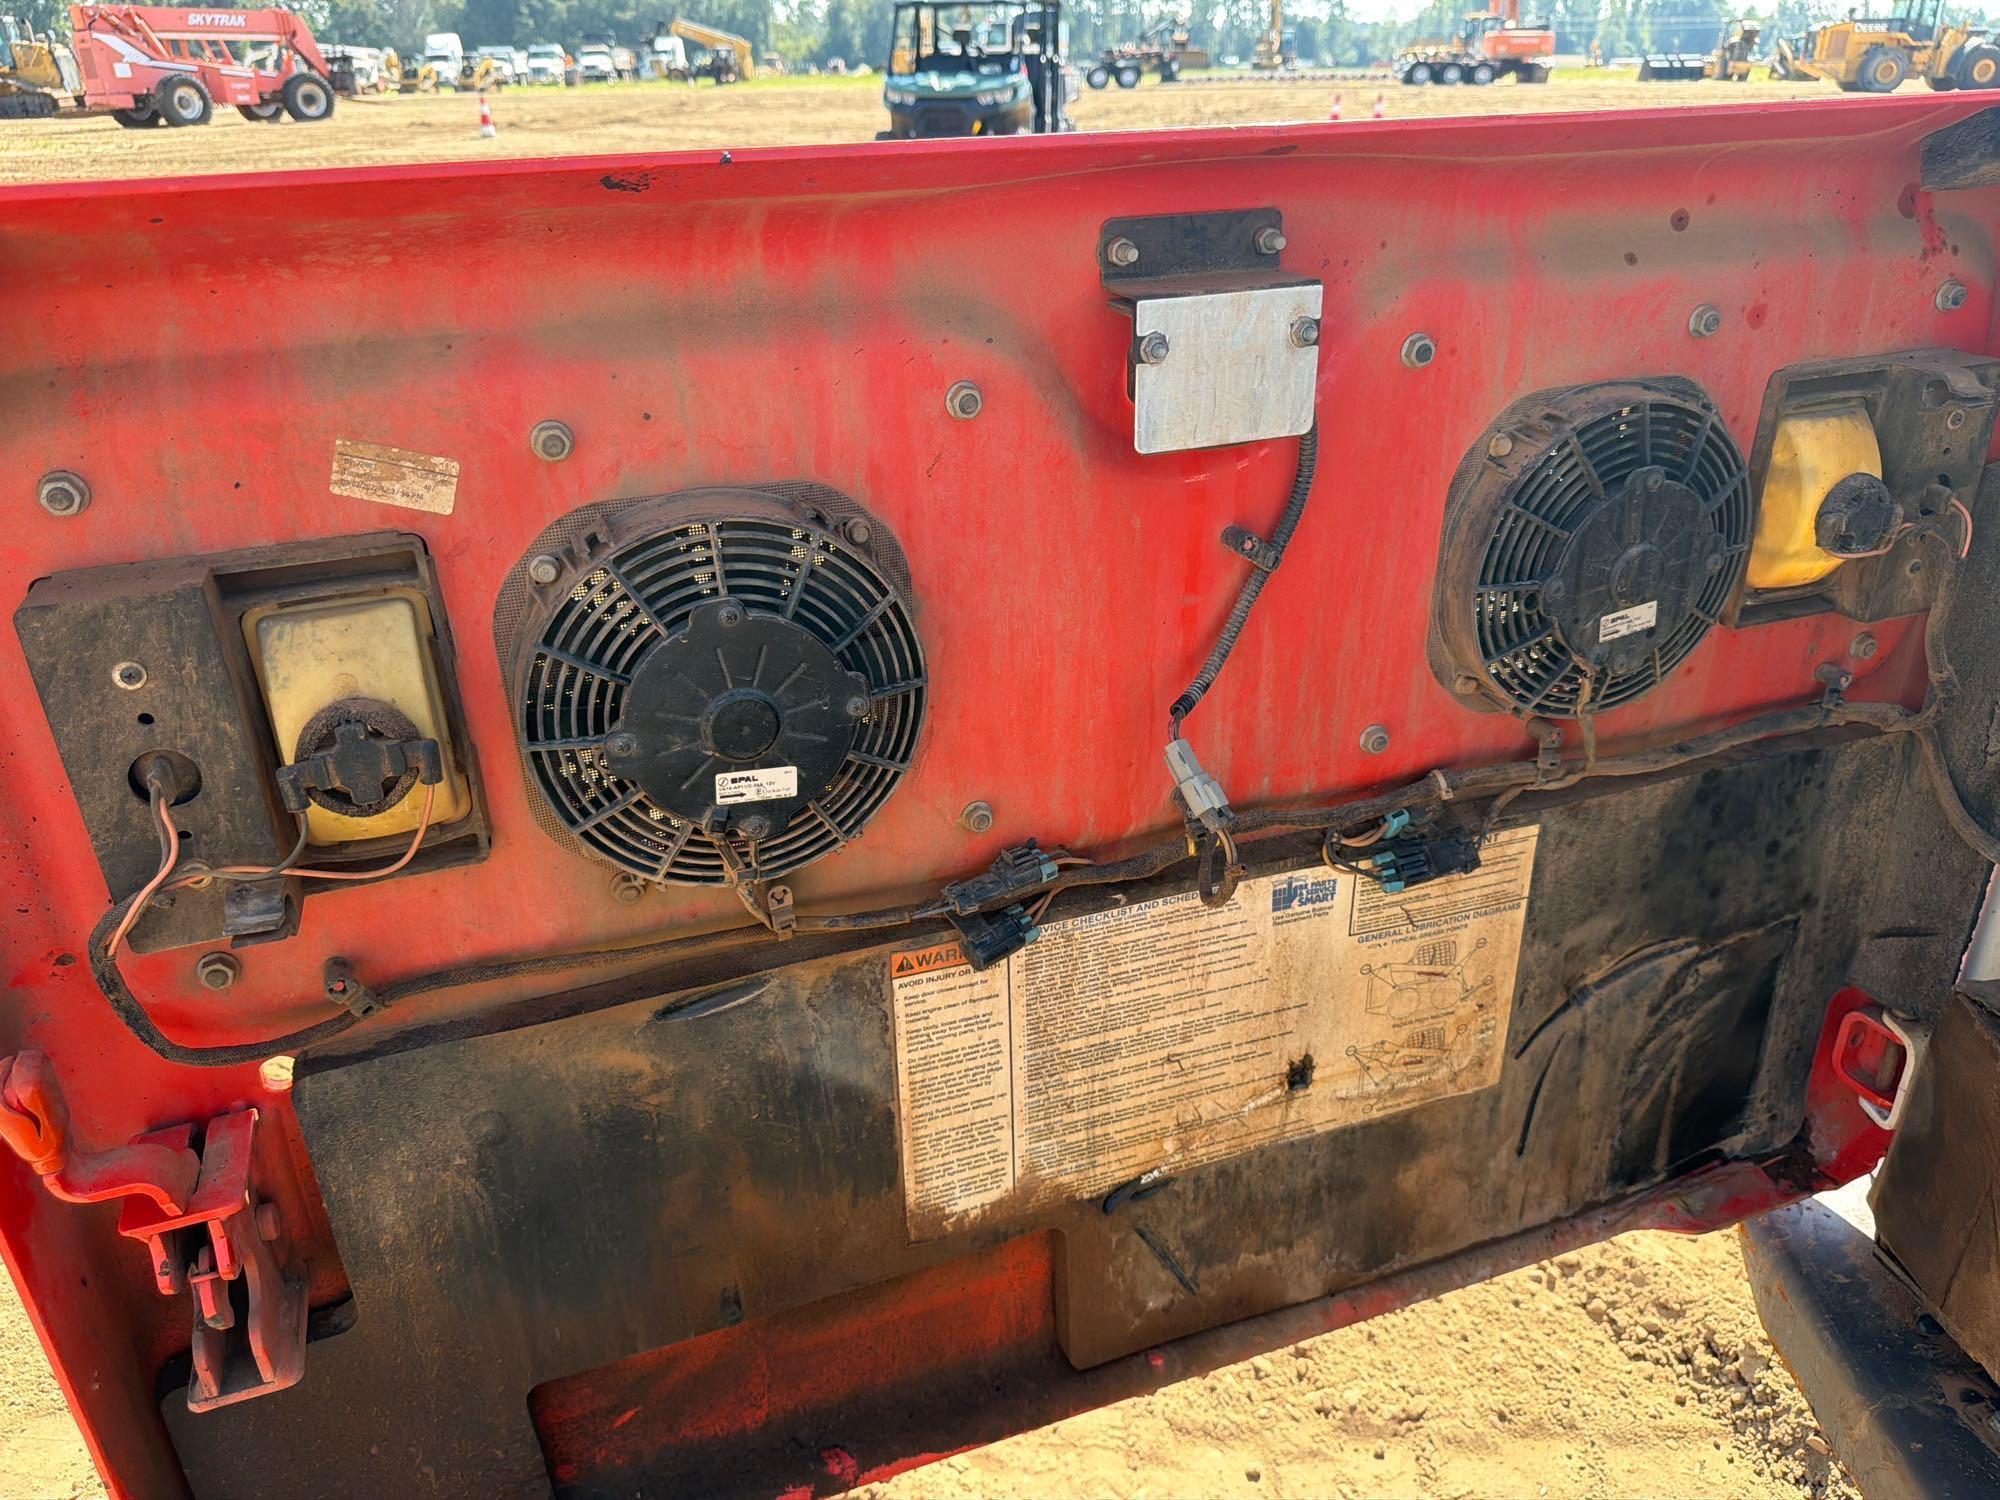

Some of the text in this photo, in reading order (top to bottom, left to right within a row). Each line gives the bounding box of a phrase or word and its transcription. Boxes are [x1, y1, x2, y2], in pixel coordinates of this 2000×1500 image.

[188, 14, 246, 26] SKYTRAK
[1855, 23, 1888, 32] DEERE
[731, 776, 758, 784] SPAL
[1311, 879, 1337, 887] PARTS
[1307, 886, 1336, 895] SERVICE
[1298, 892, 1336, 907] SMART
[1072, 907, 1132, 927] CHECKLIST
[1136, 900, 1159, 912] AND
[1162, 892, 1199, 906] SCHED
[1286, 910, 1310, 918] Genuine
[1312, 905, 1334, 913] Bobcat
[1272, 915, 1312, 926] Replacement
[1358, 902, 1521, 944] GENERAL LUBRICATION DIAGRAMS
[898, 978, 924, 990] AVOID
[926, 972, 956, 984] INJURY
[958, 968, 971, 977] OR
